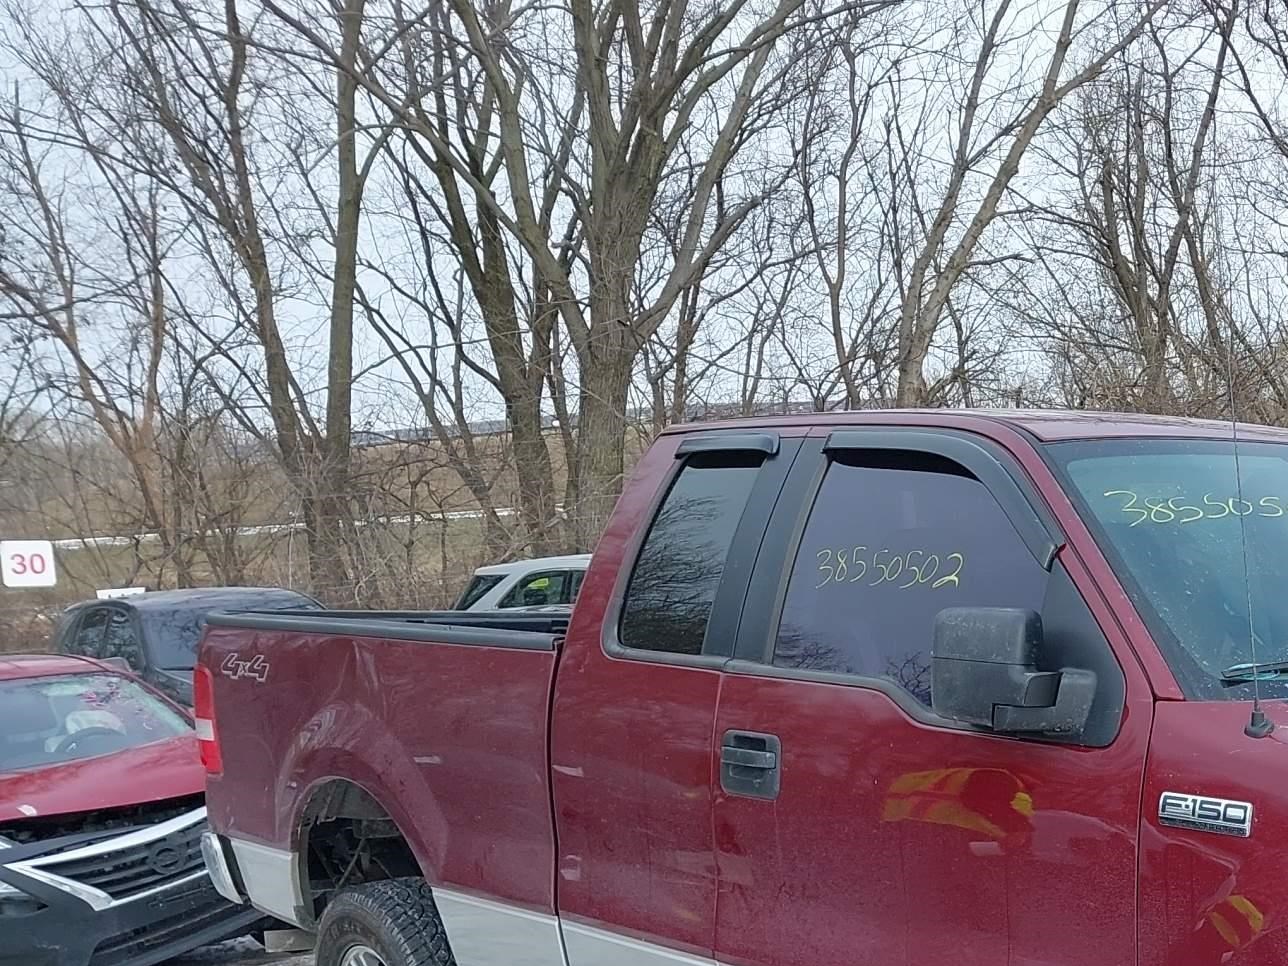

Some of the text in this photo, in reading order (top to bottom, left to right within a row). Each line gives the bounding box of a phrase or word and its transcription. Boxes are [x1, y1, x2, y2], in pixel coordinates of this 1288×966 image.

[10, 553, 46, 575] 30
[815, 546, 964, 589] 38550502
[220, 652, 269, 683] 4x4
